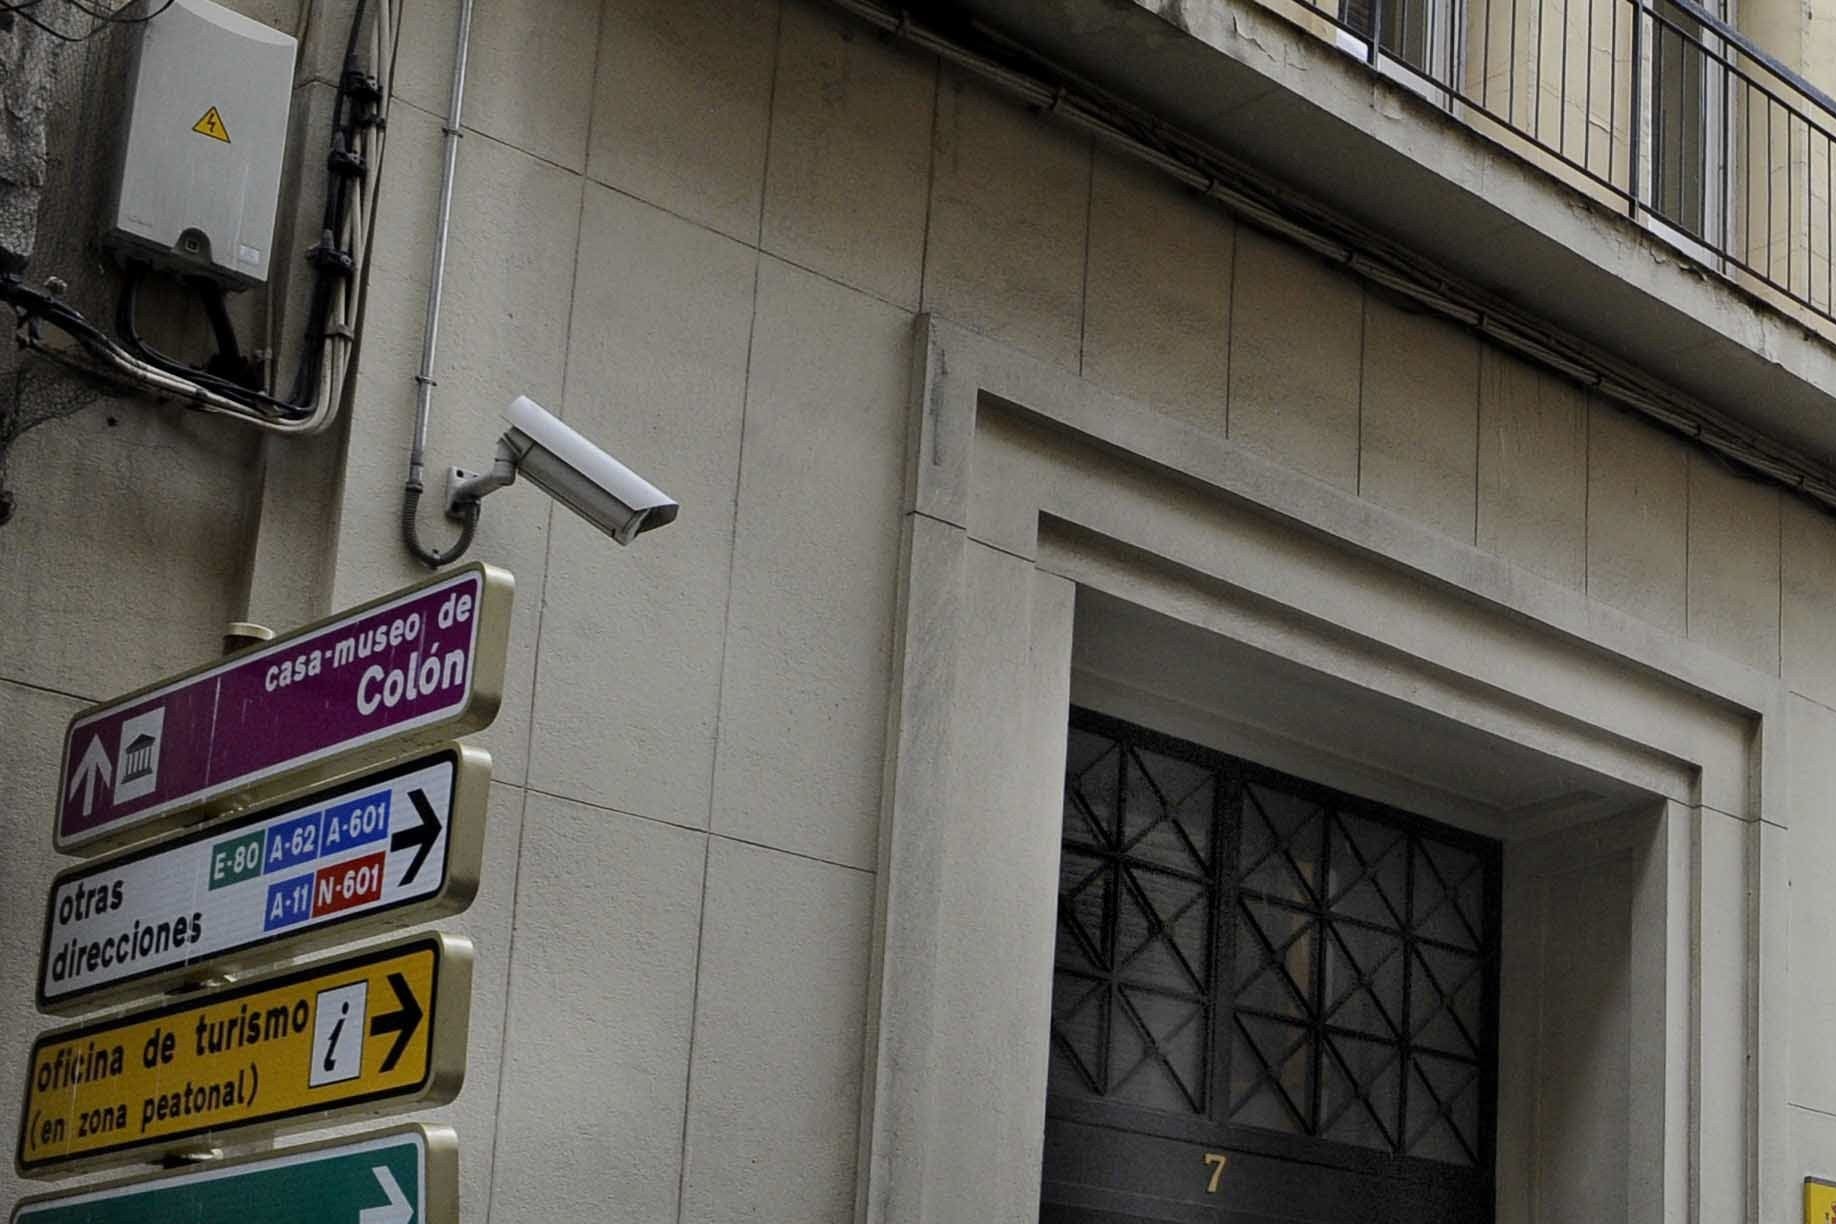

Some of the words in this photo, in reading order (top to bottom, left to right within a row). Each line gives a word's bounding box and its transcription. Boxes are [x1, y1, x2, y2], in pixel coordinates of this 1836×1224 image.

[264, 612, 420, 692] casa-museo
[438, 592, 473, 629] de
[356, 641, 465, 716] Colón
[213, 840, 260, 881] E-80
[269, 826, 316, 863] A-62
[325, 801, 387, 846] A-601
[59, 879, 125, 926] otras
[269, 883, 309, 921] A-11
[316, 862, 380, 906] N-601
[52, 911, 202, 983] direcciones
[37, 1042, 124, 1093] oficina
[143, 1028, 176, 1069] de
[195, 998, 310, 1056] turismo
[30, 1108, 66, 1152] (en
[78, 1103, 128, 1138] zona
[140, 1062, 260, 1133] peatonal)
[1204, 1153, 1227, 1193] 7
